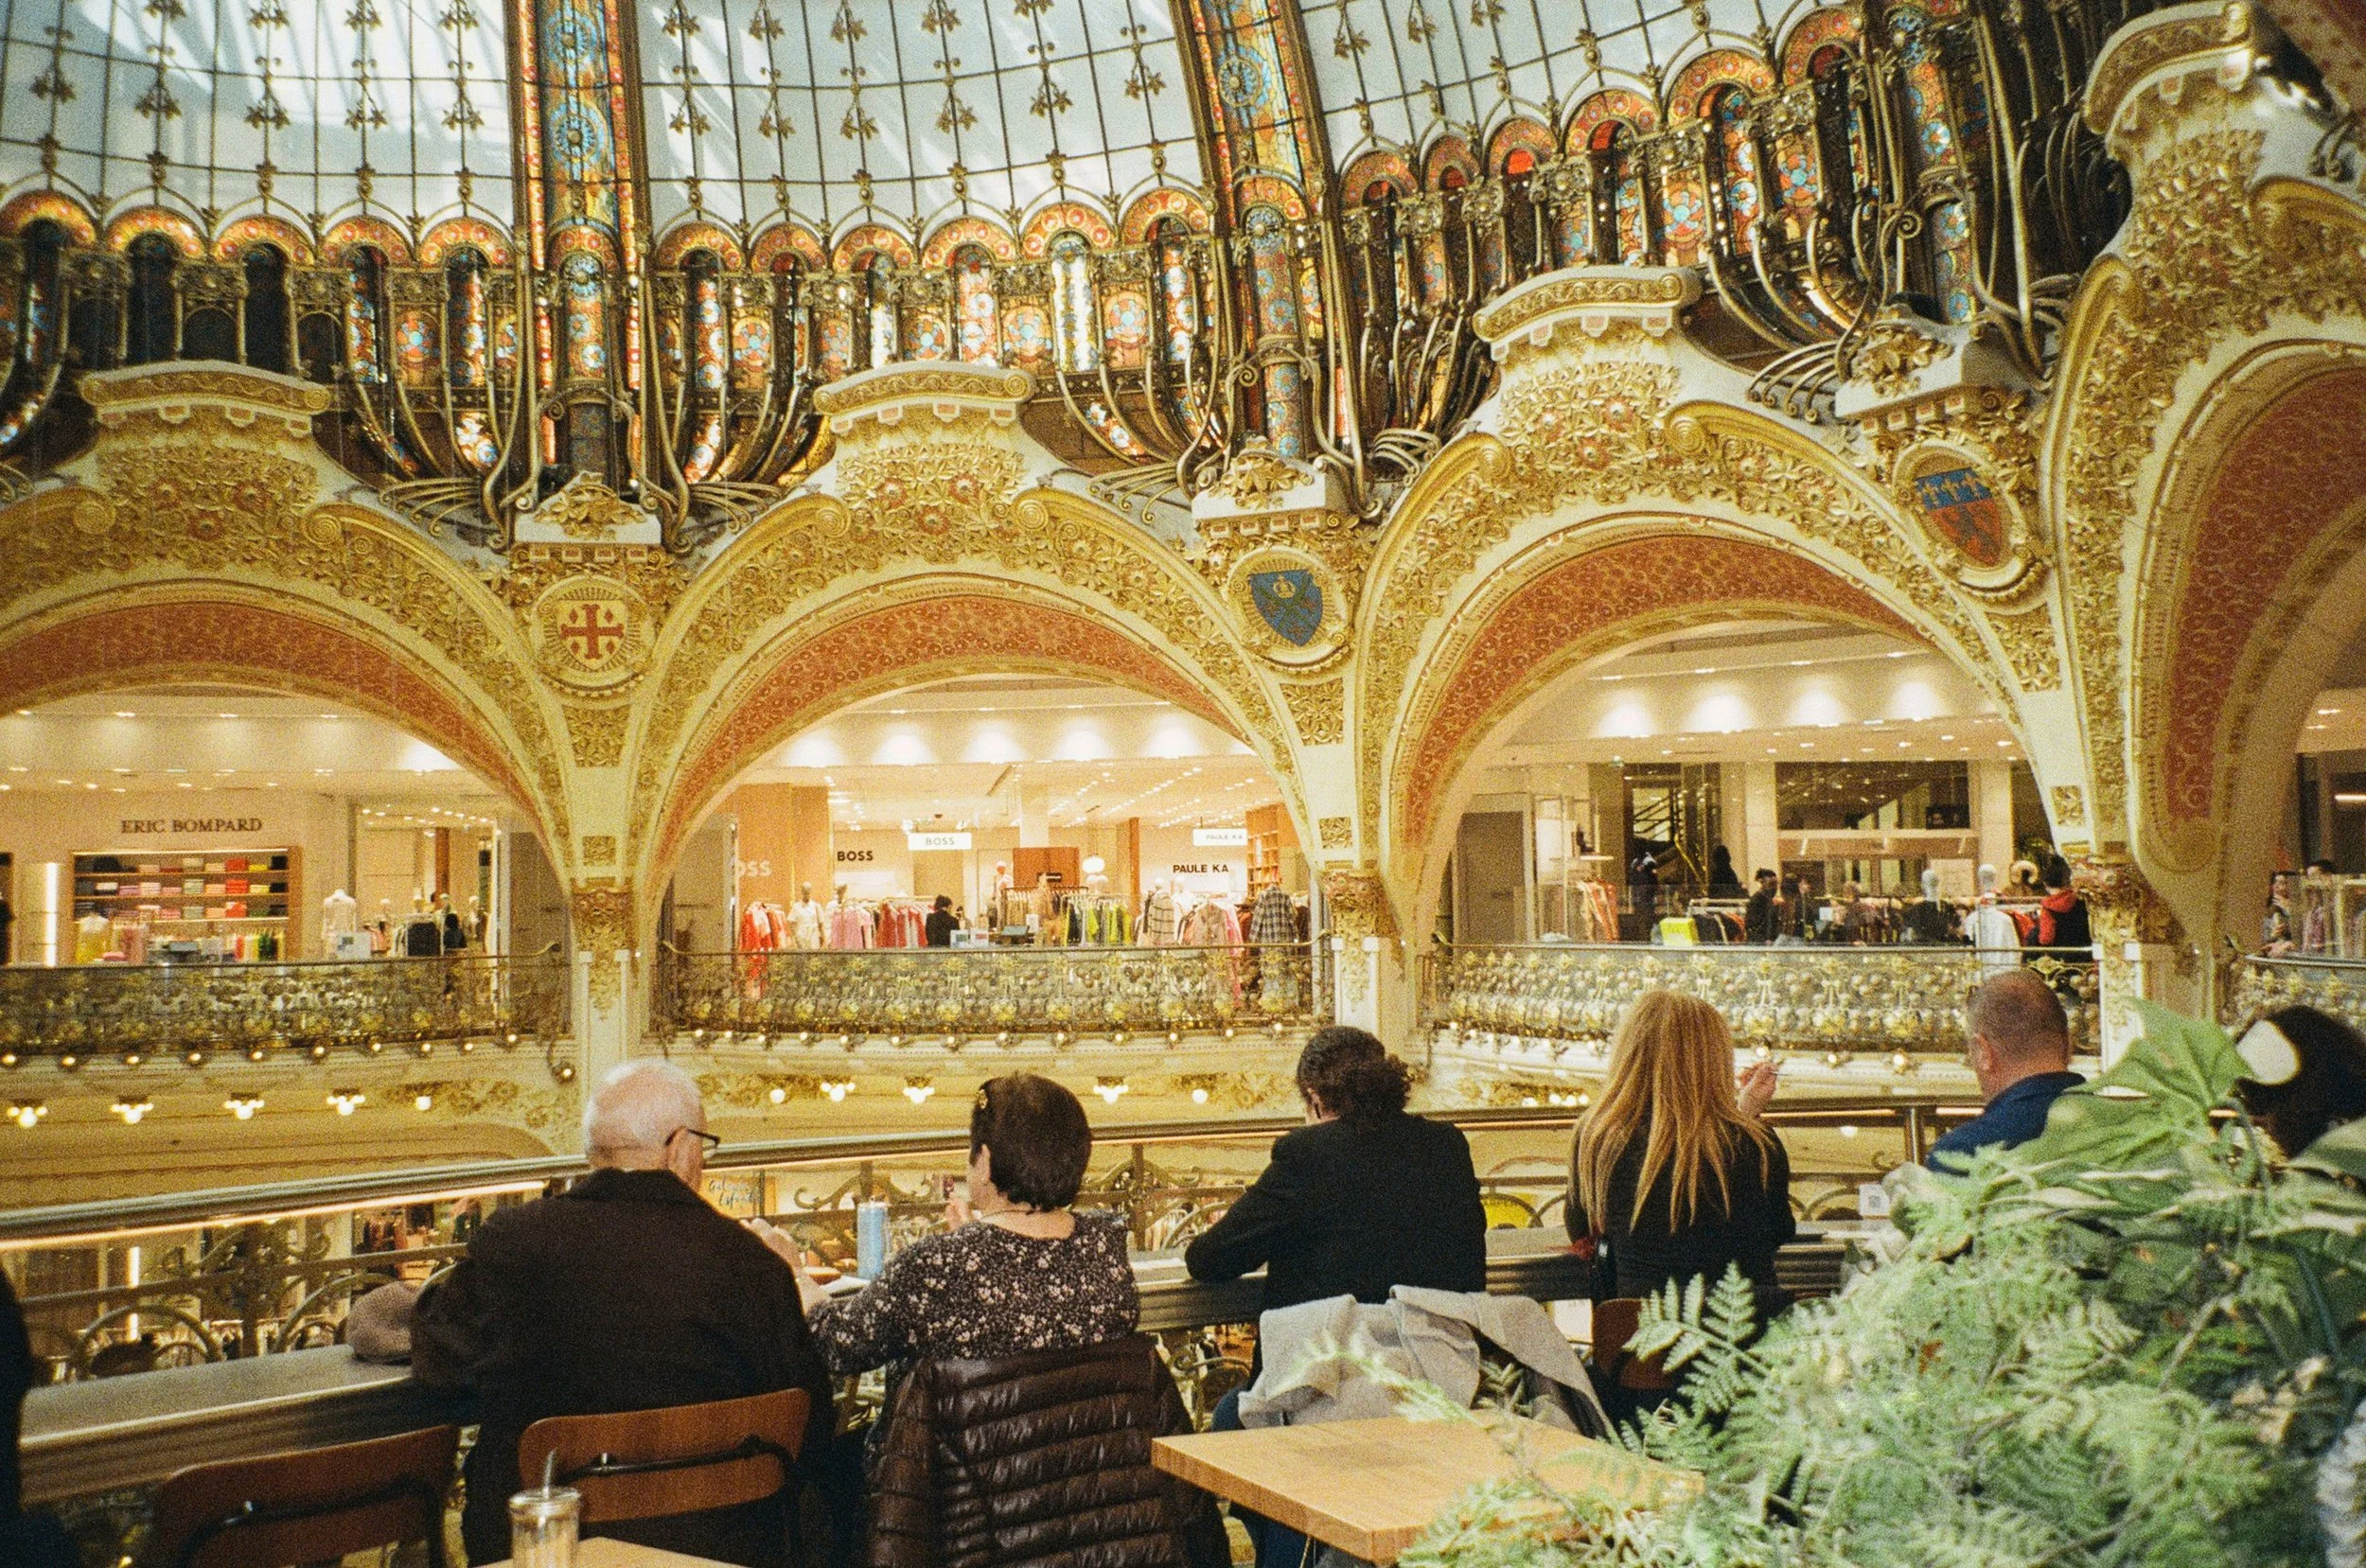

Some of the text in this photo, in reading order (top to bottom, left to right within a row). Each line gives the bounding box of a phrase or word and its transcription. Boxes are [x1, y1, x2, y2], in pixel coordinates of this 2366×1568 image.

[121, 818, 262, 834] ERIC BOMPARD
[925, 837, 955, 846] BOSS
[837, 851, 874, 861] BOSS
[1173, 864, 1228, 873] PAULE KA
